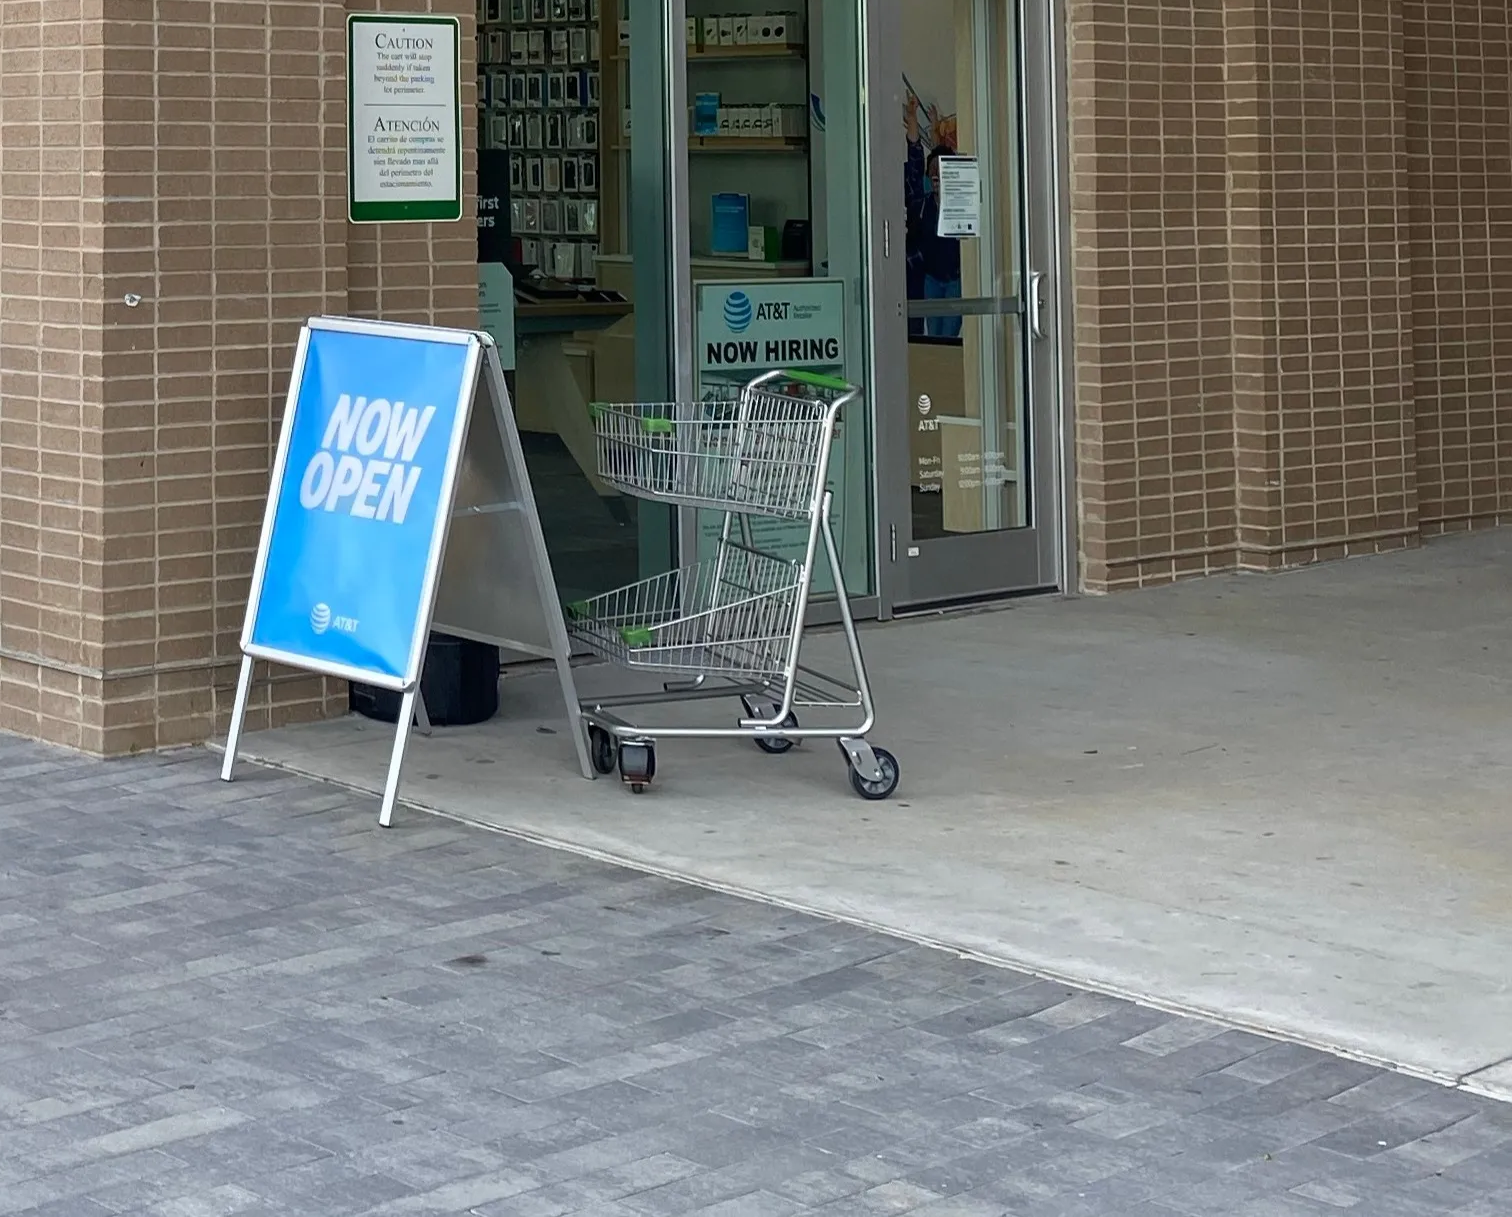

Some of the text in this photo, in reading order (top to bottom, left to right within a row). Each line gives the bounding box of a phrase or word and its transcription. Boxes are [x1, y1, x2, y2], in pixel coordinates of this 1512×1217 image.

[375, 33, 433, 49] CAUTION
[377, 52, 389, 60] The
[404, 52, 416, 60] will
[376, 63, 404, 73] suddenly
[406, 63, 412, 71] if
[374, 74, 434, 84] beyond the parking
[374, 116, 440, 132] ATENCIÓN
[399, 135, 407, 143] de
[756, 302, 790, 320] AT&T
[707, 338, 839, 364] NOW HIRING
[321, 393, 436, 462] NOW
[918, 419, 940, 431] AT&T
[918, 455, 941, 465] Mon-Fri
[919, 470, 944, 479] Saturday
[299, 451, 422, 524] OPEN
[919, 483, 940, 493] Sunday
[332, 616, 360, 633] AT&T
